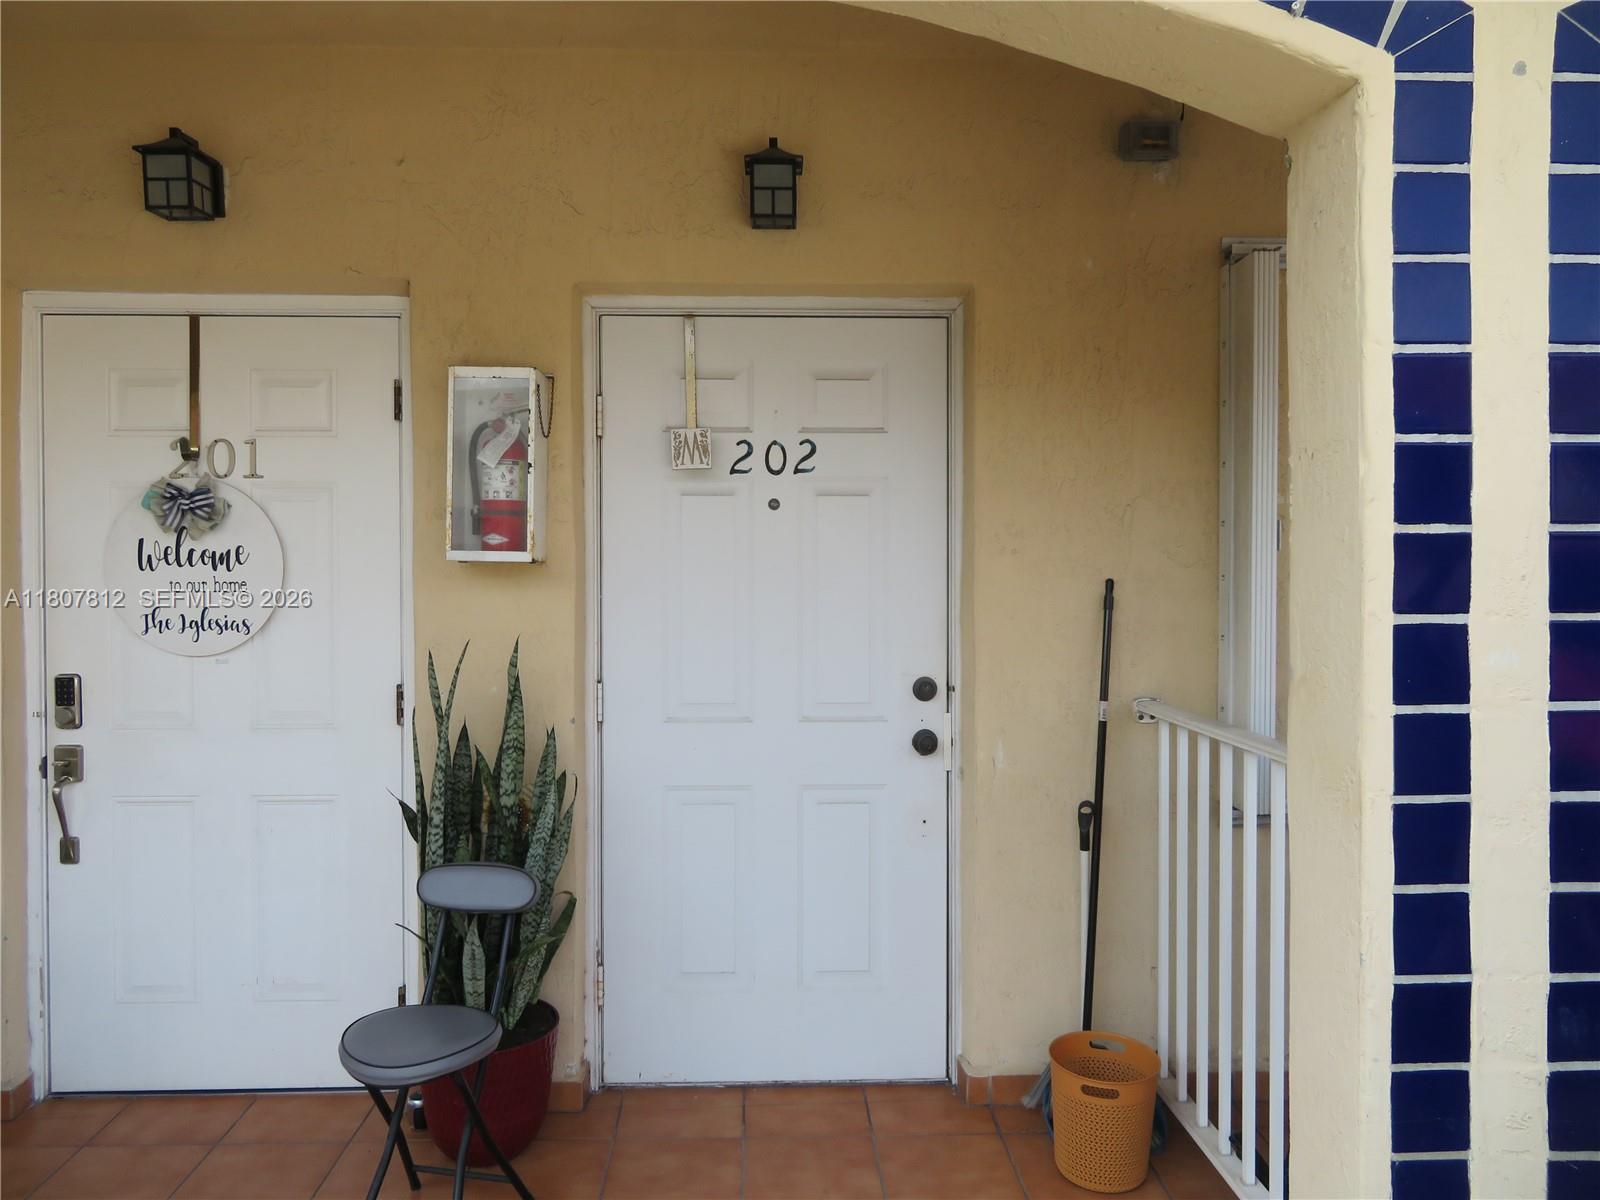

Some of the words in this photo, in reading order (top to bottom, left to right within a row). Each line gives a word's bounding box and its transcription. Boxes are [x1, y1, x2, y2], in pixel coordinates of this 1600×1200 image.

[729, 438, 817, 476] 202
[137, 526, 250, 573] Welcome
[186, 581, 208, 594] our
[213, 575, 248, 593] home
[140, 606, 174, 636] The
[178, 606, 253, 643] Iglesias
